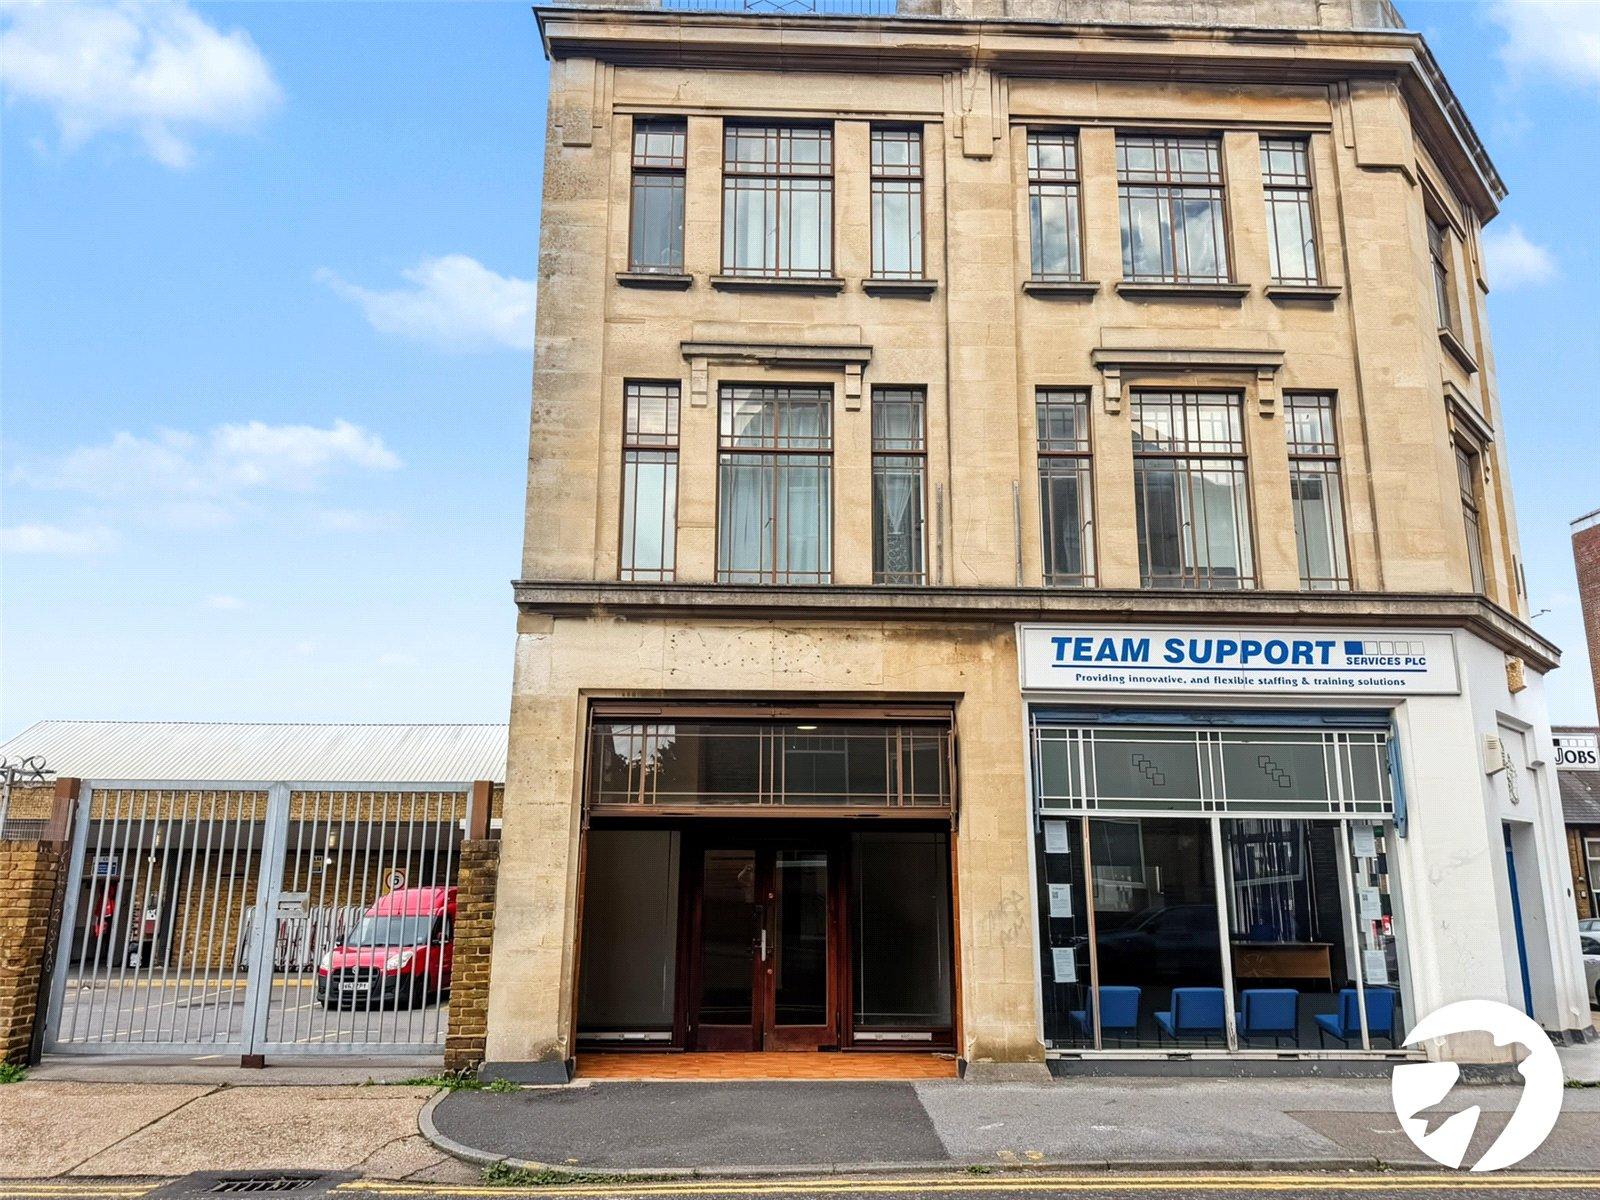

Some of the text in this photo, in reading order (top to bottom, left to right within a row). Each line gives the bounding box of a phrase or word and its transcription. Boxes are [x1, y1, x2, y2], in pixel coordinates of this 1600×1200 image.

[1051, 637, 1336, 665] TEAM SUPPORT
[1346, 657, 1426, 666] SERVICES PLC
[1075, 673, 1125, 684] Providing
[1190, 675, 1210, 685] and
[1214, 676, 1255, 685] flexible
[1258, 676, 1298, 687] staffing
[1301, 677, 1310, 686] &
[1313, 677, 1355, 688] training
[1358, 677, 1406, 686] solutions
[1554, 747, 1596, 765] JOBS
